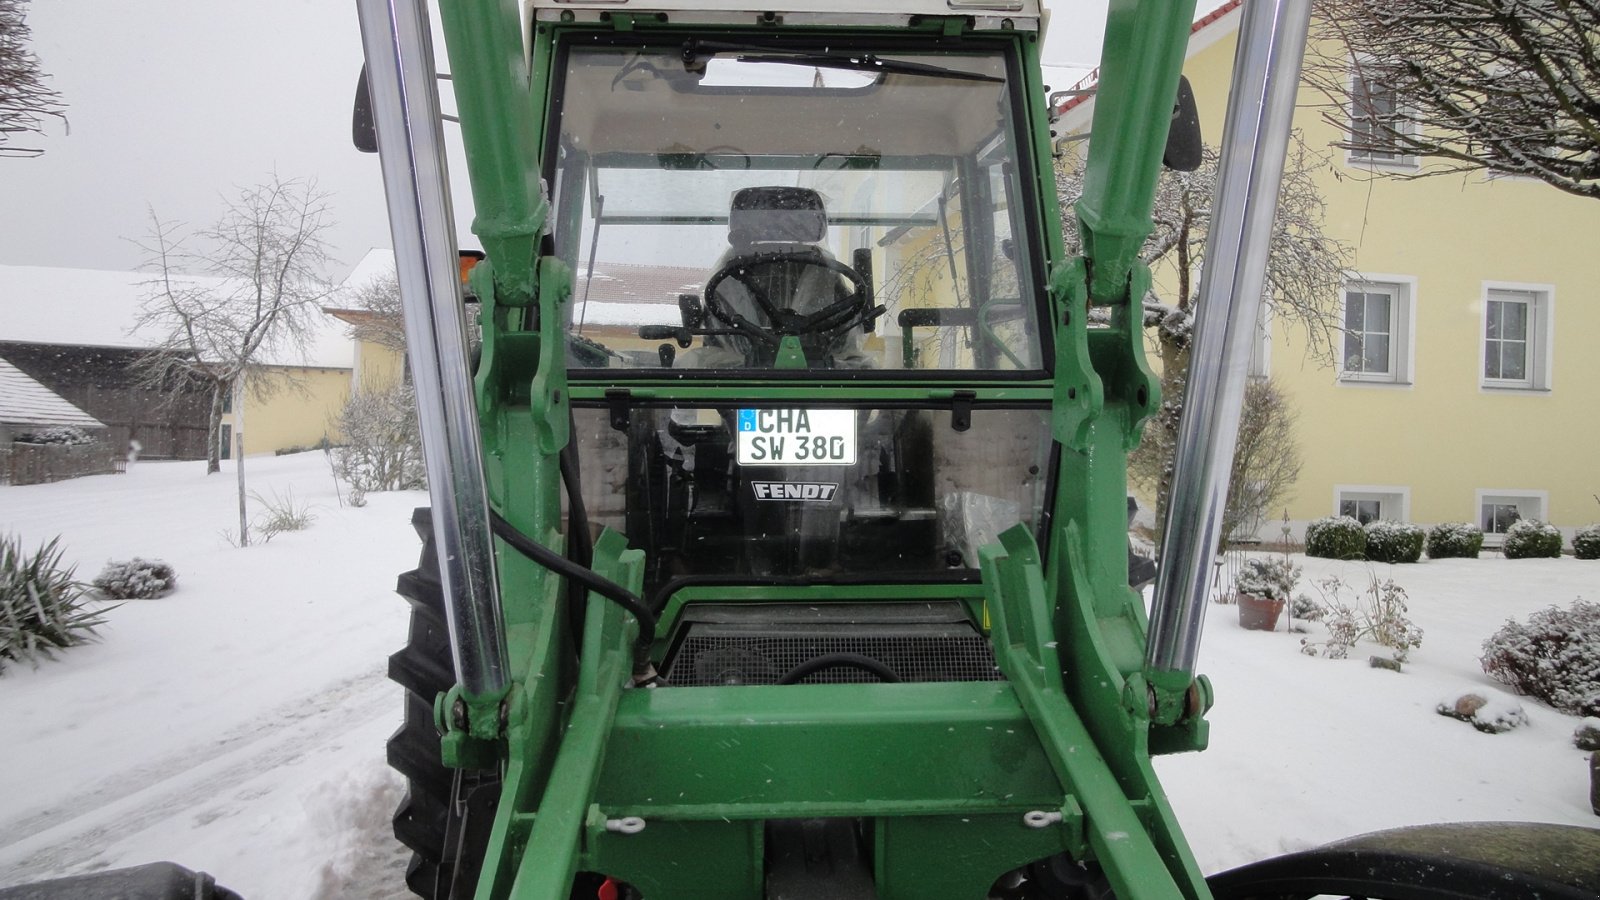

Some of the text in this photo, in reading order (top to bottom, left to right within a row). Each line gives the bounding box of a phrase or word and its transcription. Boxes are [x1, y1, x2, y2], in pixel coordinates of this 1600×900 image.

[744, 421, 752, 431] D
[758, 409, 811, 433] CHA
[751, 436, 845, 460] SW 380
[754, 483, 836, 499] FENDT
